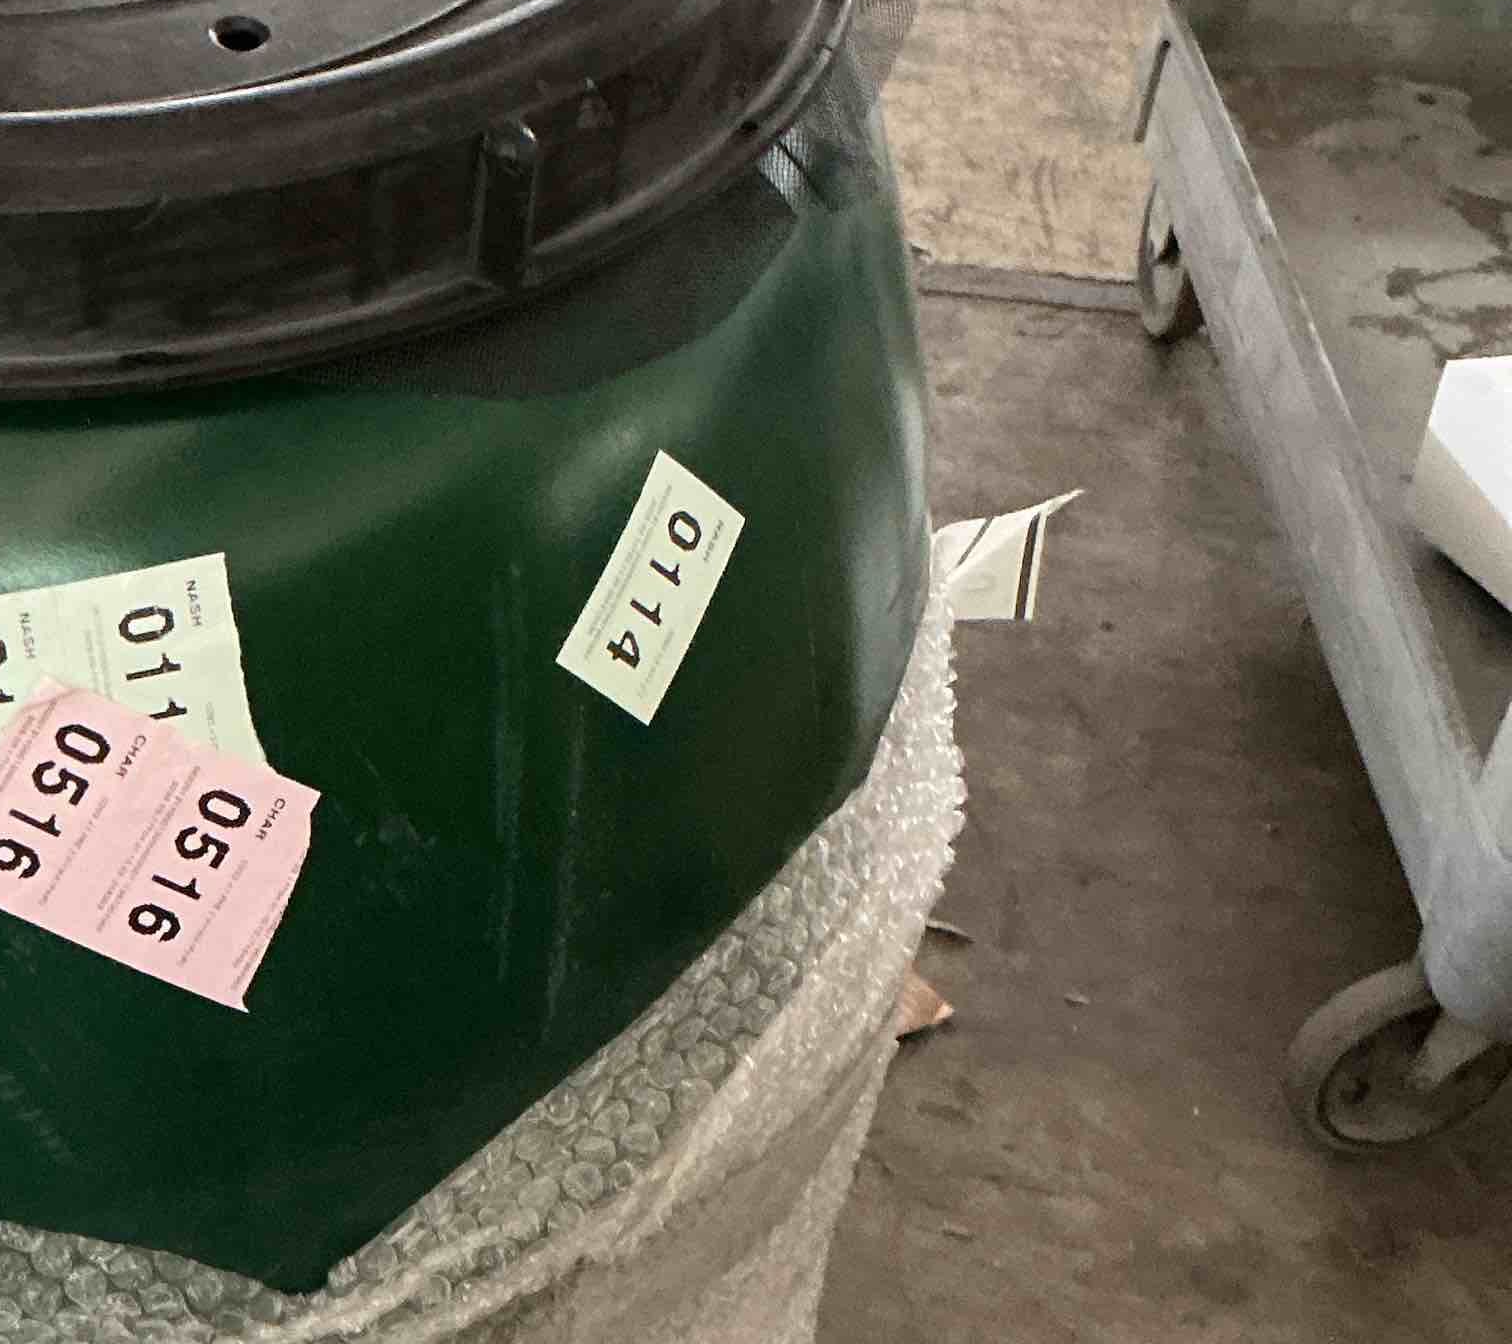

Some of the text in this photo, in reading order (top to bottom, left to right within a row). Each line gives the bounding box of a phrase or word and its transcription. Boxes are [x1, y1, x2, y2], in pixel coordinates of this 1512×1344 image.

[605, 510, 702, 670] 0114
[118, 605, 188, 721] 011
[115, 733, 148, 779] CHAR
[127, 788, 253, 944] 0516
[255, 796, 287, 842] CHAR
